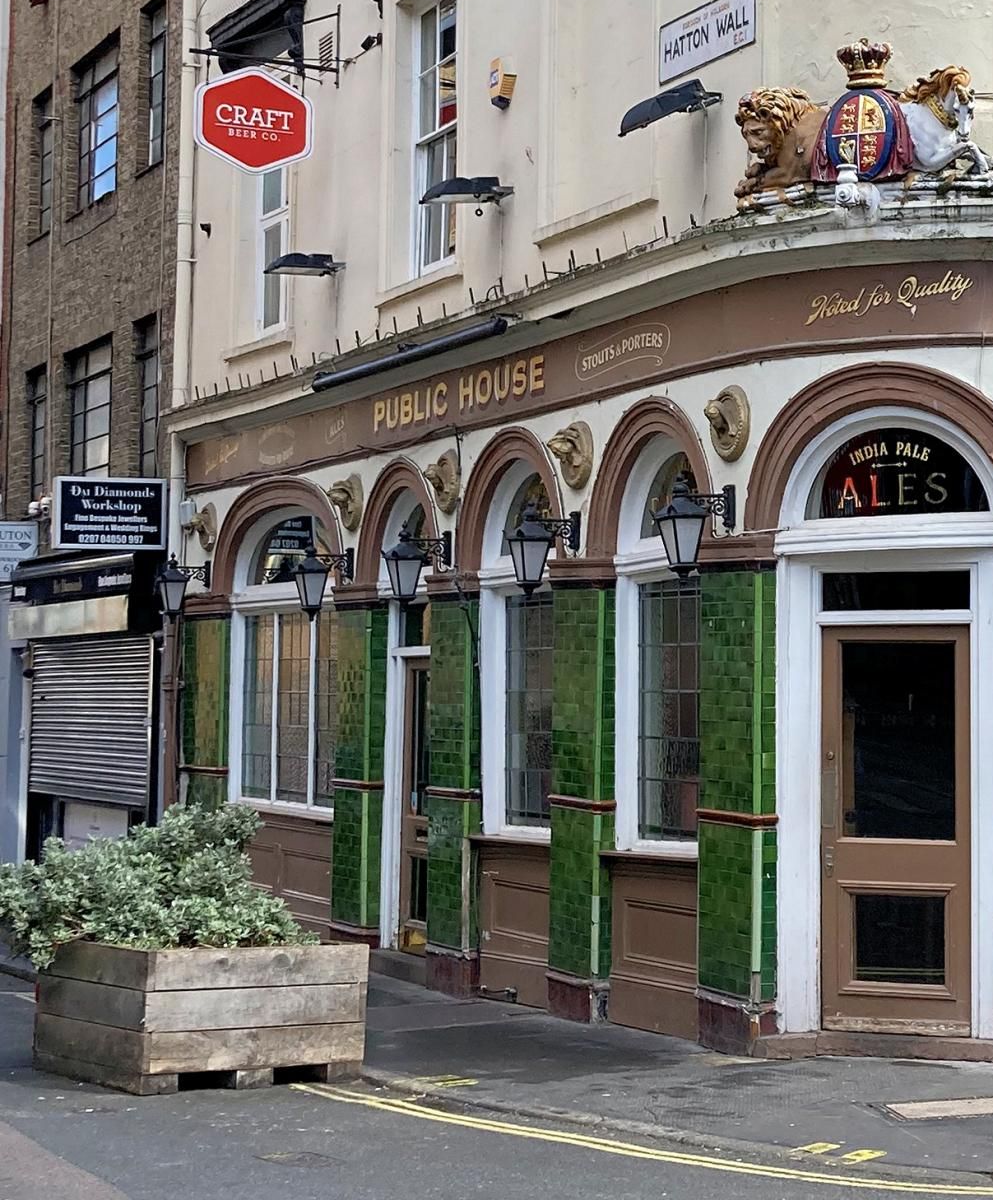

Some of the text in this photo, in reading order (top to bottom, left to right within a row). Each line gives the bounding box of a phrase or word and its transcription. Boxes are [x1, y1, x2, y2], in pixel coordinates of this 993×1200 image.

[664, 5, 749, 63] HATTON WALL
[215, 103, 294, 131] CRAFT
[228, 128, 281, 142] BEER CO.
[804, 270, 974, 326] Noted for Quality
[582, 344, 615, 372] STOUTS
[621, 332, 663, 354] PORTERS
[373, 354, 545, 433] PUBLIC HOUSE
[848, 441, 931, 466] INDIA PALE
[81, 499, 142, 514] Workshop
[94, 485, 155, 498] Diamonds
[838, 472, 948, 509] ALES
